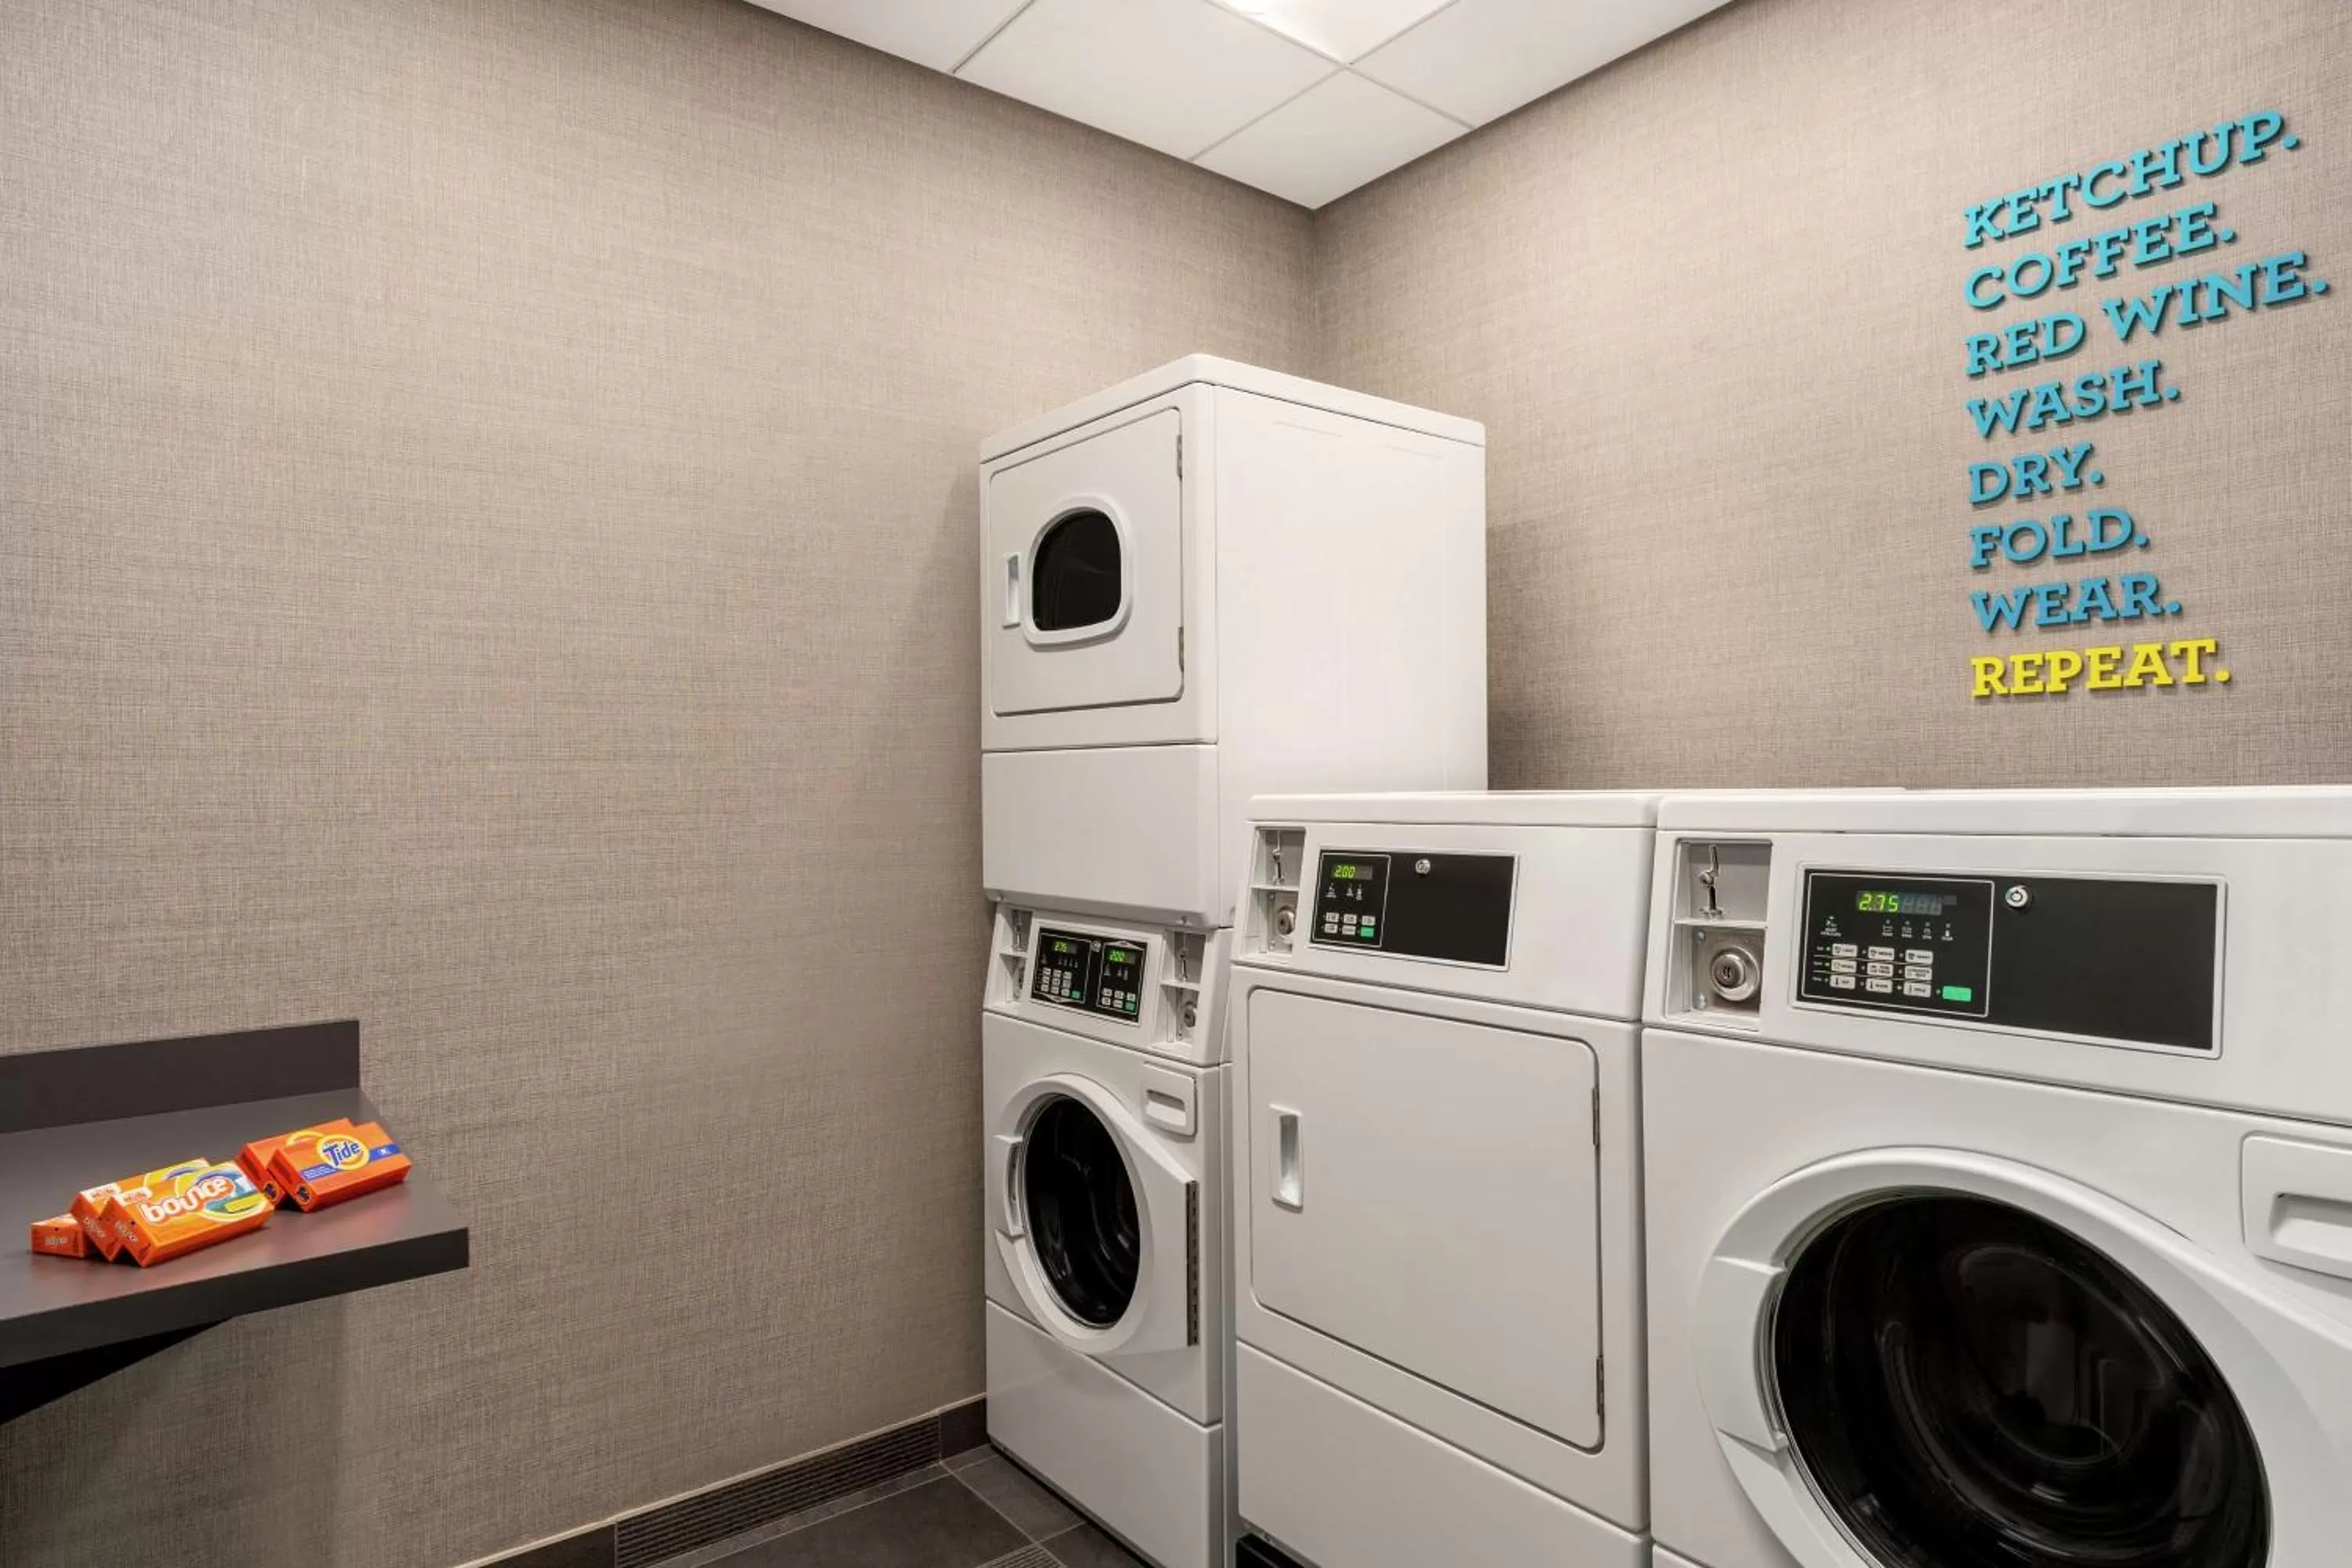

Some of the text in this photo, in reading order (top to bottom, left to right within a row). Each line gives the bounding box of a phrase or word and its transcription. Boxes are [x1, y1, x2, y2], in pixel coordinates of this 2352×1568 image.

[1964, 109, 2299, 249] KETCHUP.
[1965, 201, 2236, 310] COFFEE.
[1965, 250, 2330, 377] RED WINE.
[1966, 358, 2181, 438] WASH.
[1968, 442, 2104, 505] DRY.
[1969, 508, 2150, 568] FOLD.
[1970, 572, 2183, 632] WEAR.
[1970, 637, 2232, 698] REPEAT.
[322, 1142, 361, 1166] Tide
[140, 1178, 227, 1223] bounce
